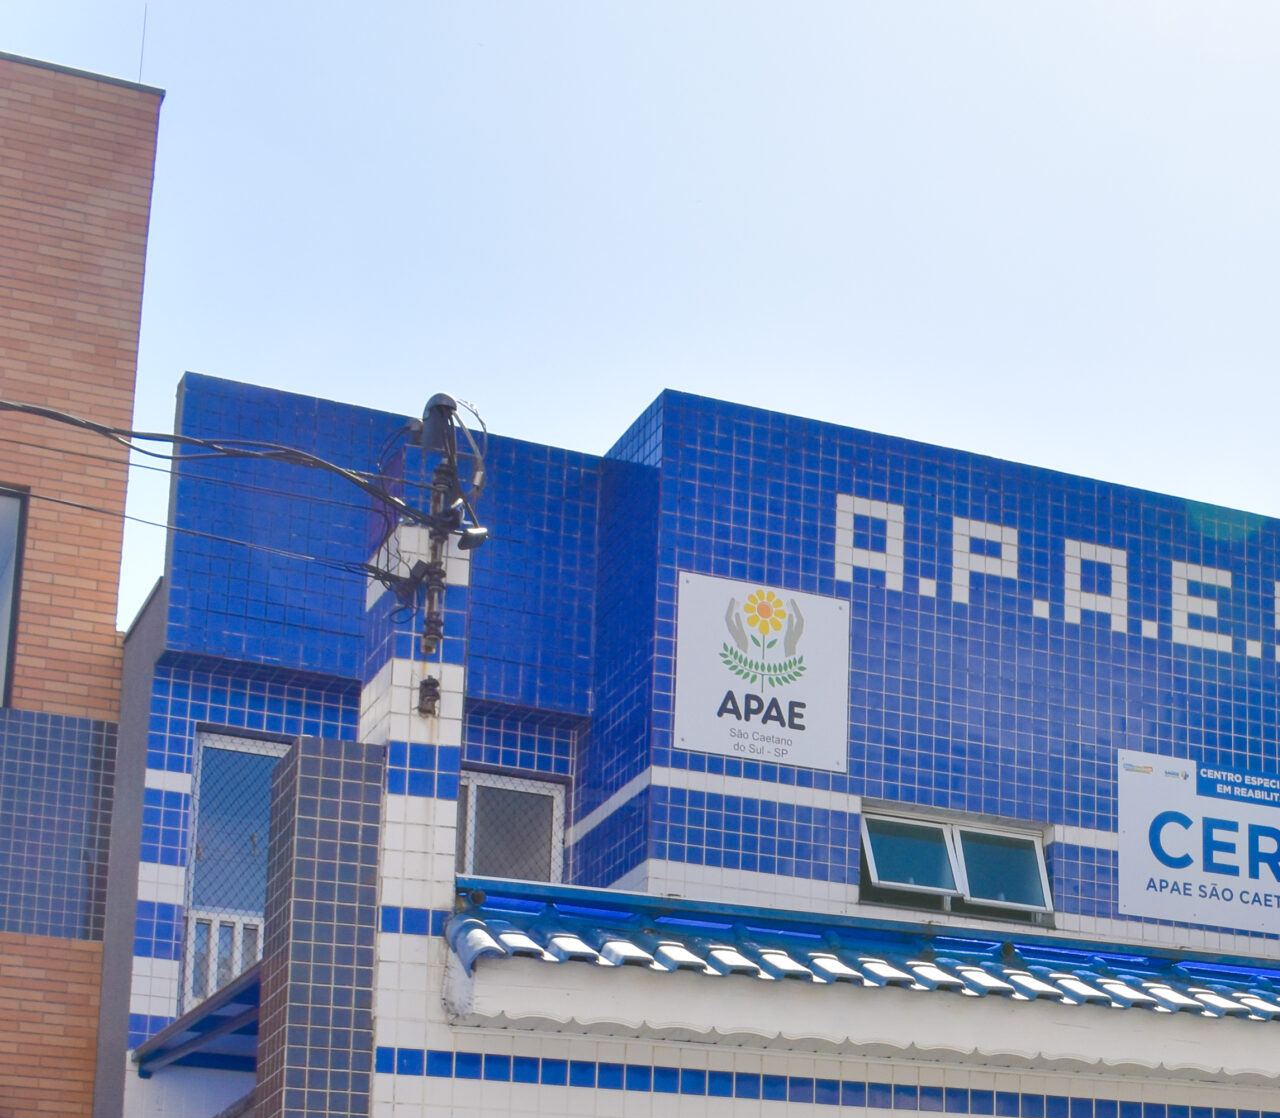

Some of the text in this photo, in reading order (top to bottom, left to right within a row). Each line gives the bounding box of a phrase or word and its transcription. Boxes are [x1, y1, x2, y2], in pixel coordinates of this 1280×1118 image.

[716, 689, 807, 731] APAE
[729, 728, 793, 747] São Caetano
[733, 742, 746, 752] do
[749, 745, 765, 755] Sul
[774, 748, 789, 758] SP
[1200, 768, 1243, 785] CENTRO
[1216, 783, 1232, 794] EM
[1146, 877, 1193, 896] APAE
[1198, 882, 1234, 902] SÃO
